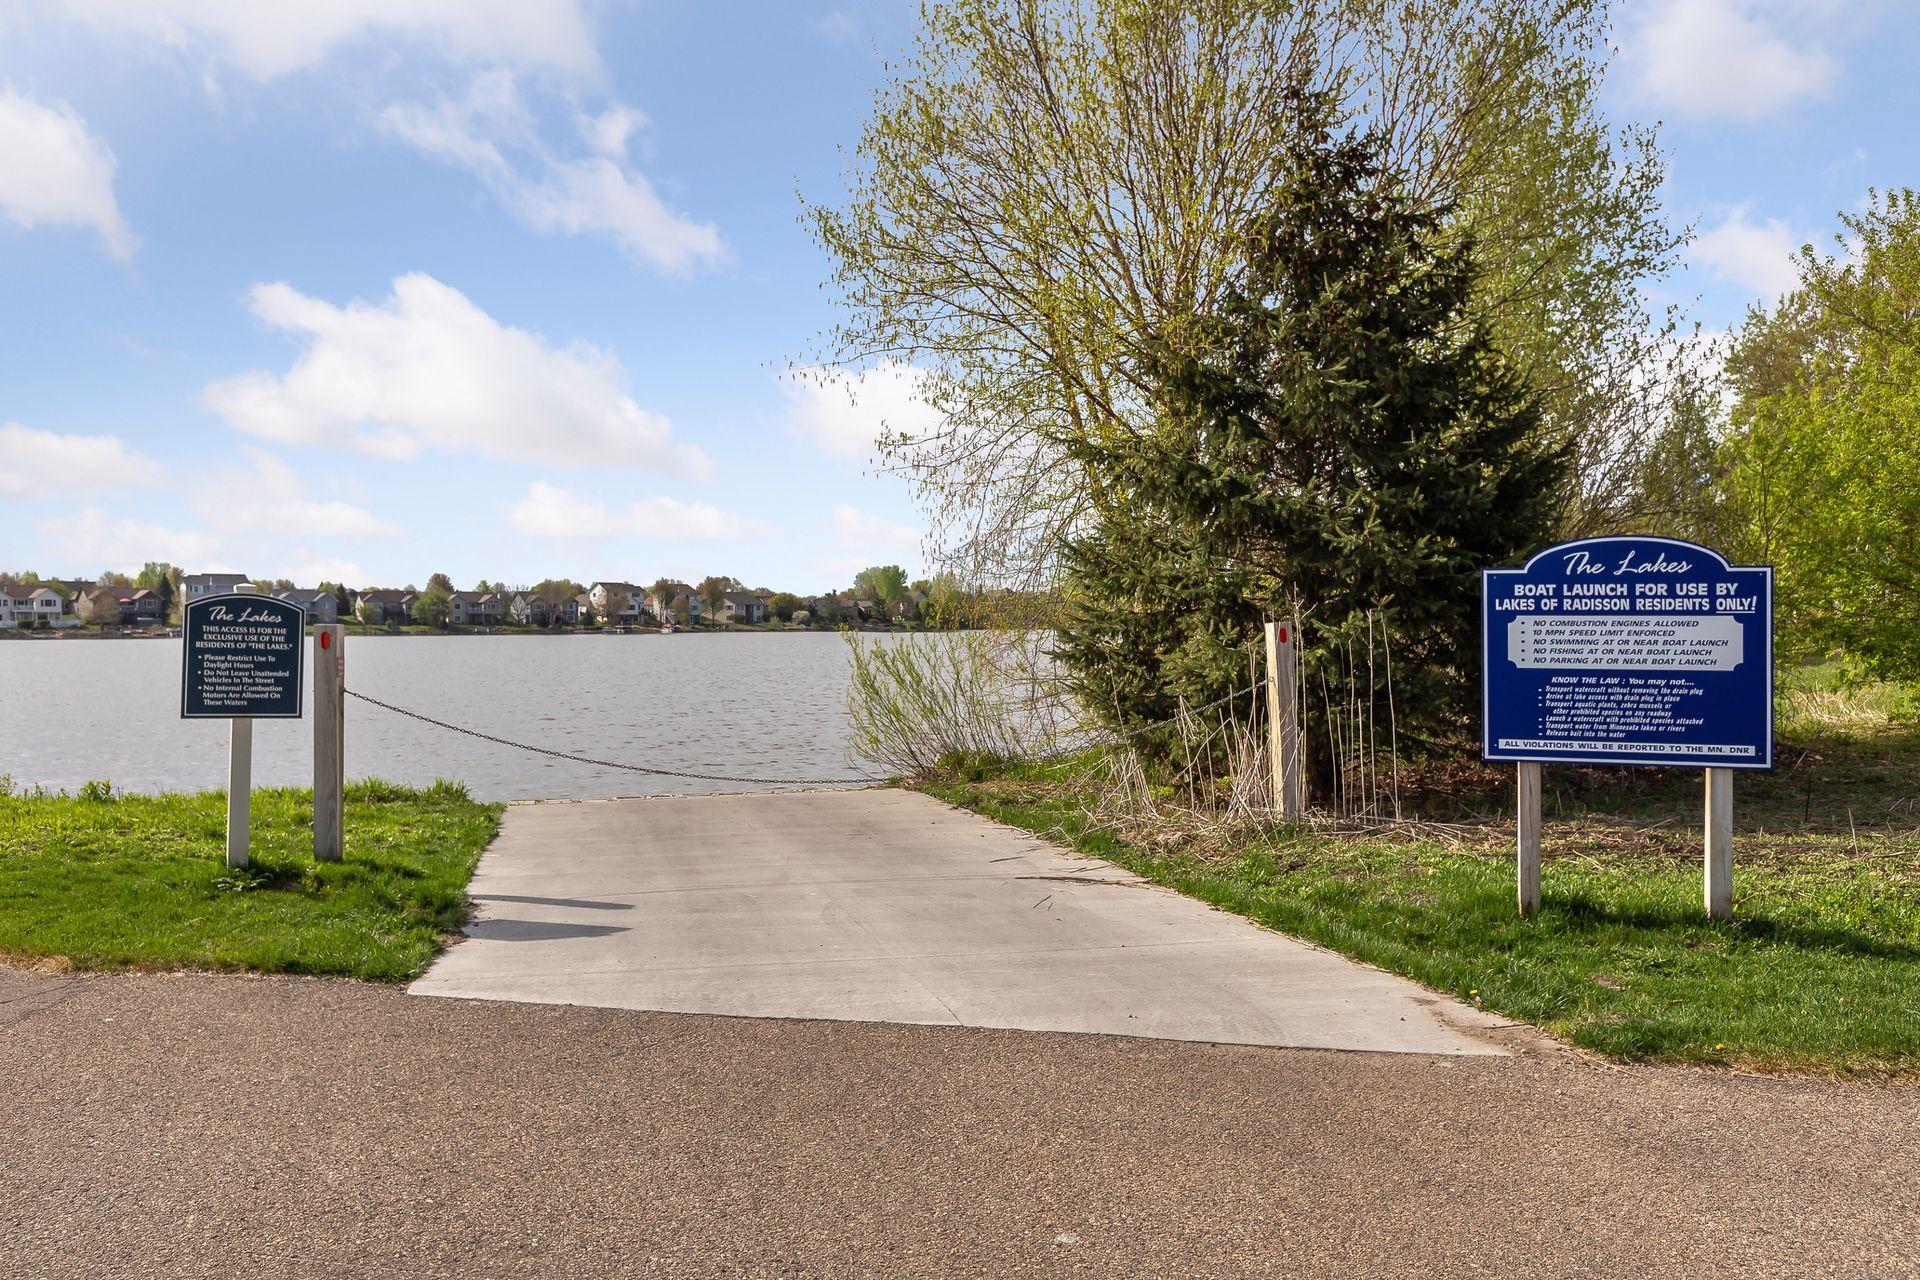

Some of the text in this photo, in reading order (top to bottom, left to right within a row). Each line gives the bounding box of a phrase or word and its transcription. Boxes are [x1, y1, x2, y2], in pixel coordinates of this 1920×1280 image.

[1563, 550, 1692, 575] The Lakes
[1514, 583, 1738, 596] BOAT LAUNCH FOR USE BY
[1495, 595, 1757, 613] LAKES OF RADISSON RESIDENTS ONLY!
[209, 606, 282, 623] The Lakes
[1546, 685, 1573, 693] Transport
[1546, 700, 1573, 708] Transport
[1647, 710, 1672, 718] roadway
[1523, 741, 1574, 749] VIOLATIONS
[1618, 744, 1665, 752] REPORTED
